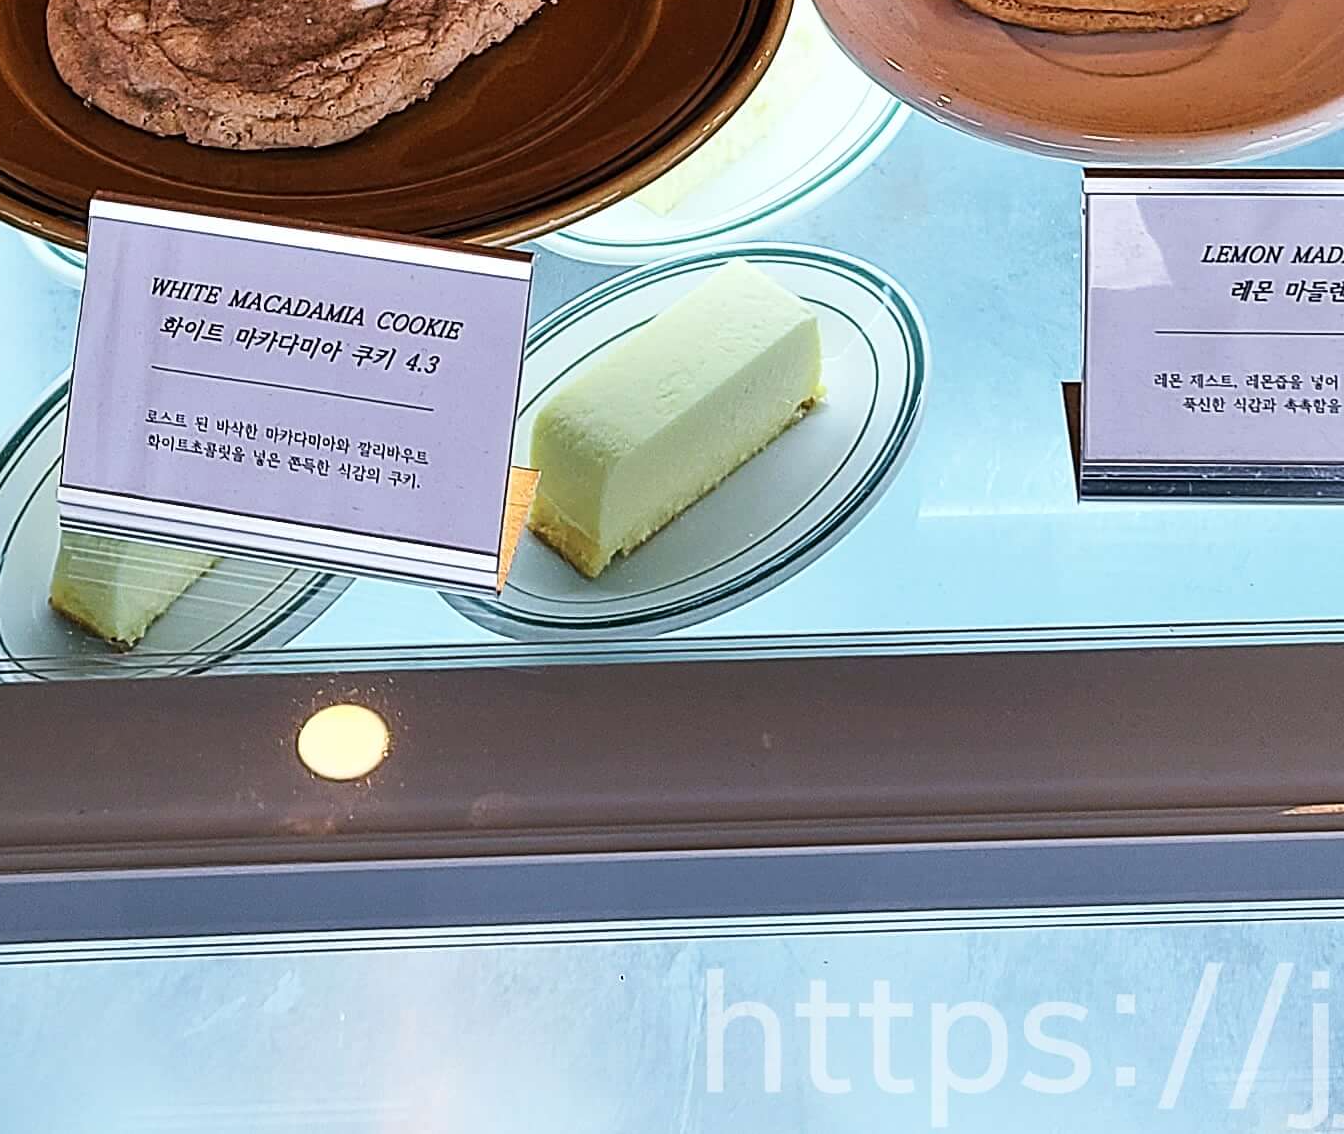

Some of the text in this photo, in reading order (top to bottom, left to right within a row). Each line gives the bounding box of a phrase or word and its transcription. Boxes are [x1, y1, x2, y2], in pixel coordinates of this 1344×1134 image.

[1201, 245, 1284, 264] LEMON
[151, 277, 463, 341] WHITE MACADAMIA COOKIE
[1231, 280, 1274, 302] 레몬
[160, 316, 440, 374] 화이트 마카다미아 쿠키 4.3
[1154, 373, 1183, 389] 레몬
[1246, 373, 1304, 390] 레몬즙을
[1311, 374, 1338, 391] 넣어
[1182, 397, 1226, 414] 푹신한
[1233, 397, 1277, 414] 식감과
[1284, 398, 1342, 414] 촉촉함을
[145, 410, 428, 465] 로스트 된 바삭한 마카다미아와 깔리바우트
[147, 433, 421, 489] 화이트초콜릿을 넣은 쫀득한 식감의 쿠키.
